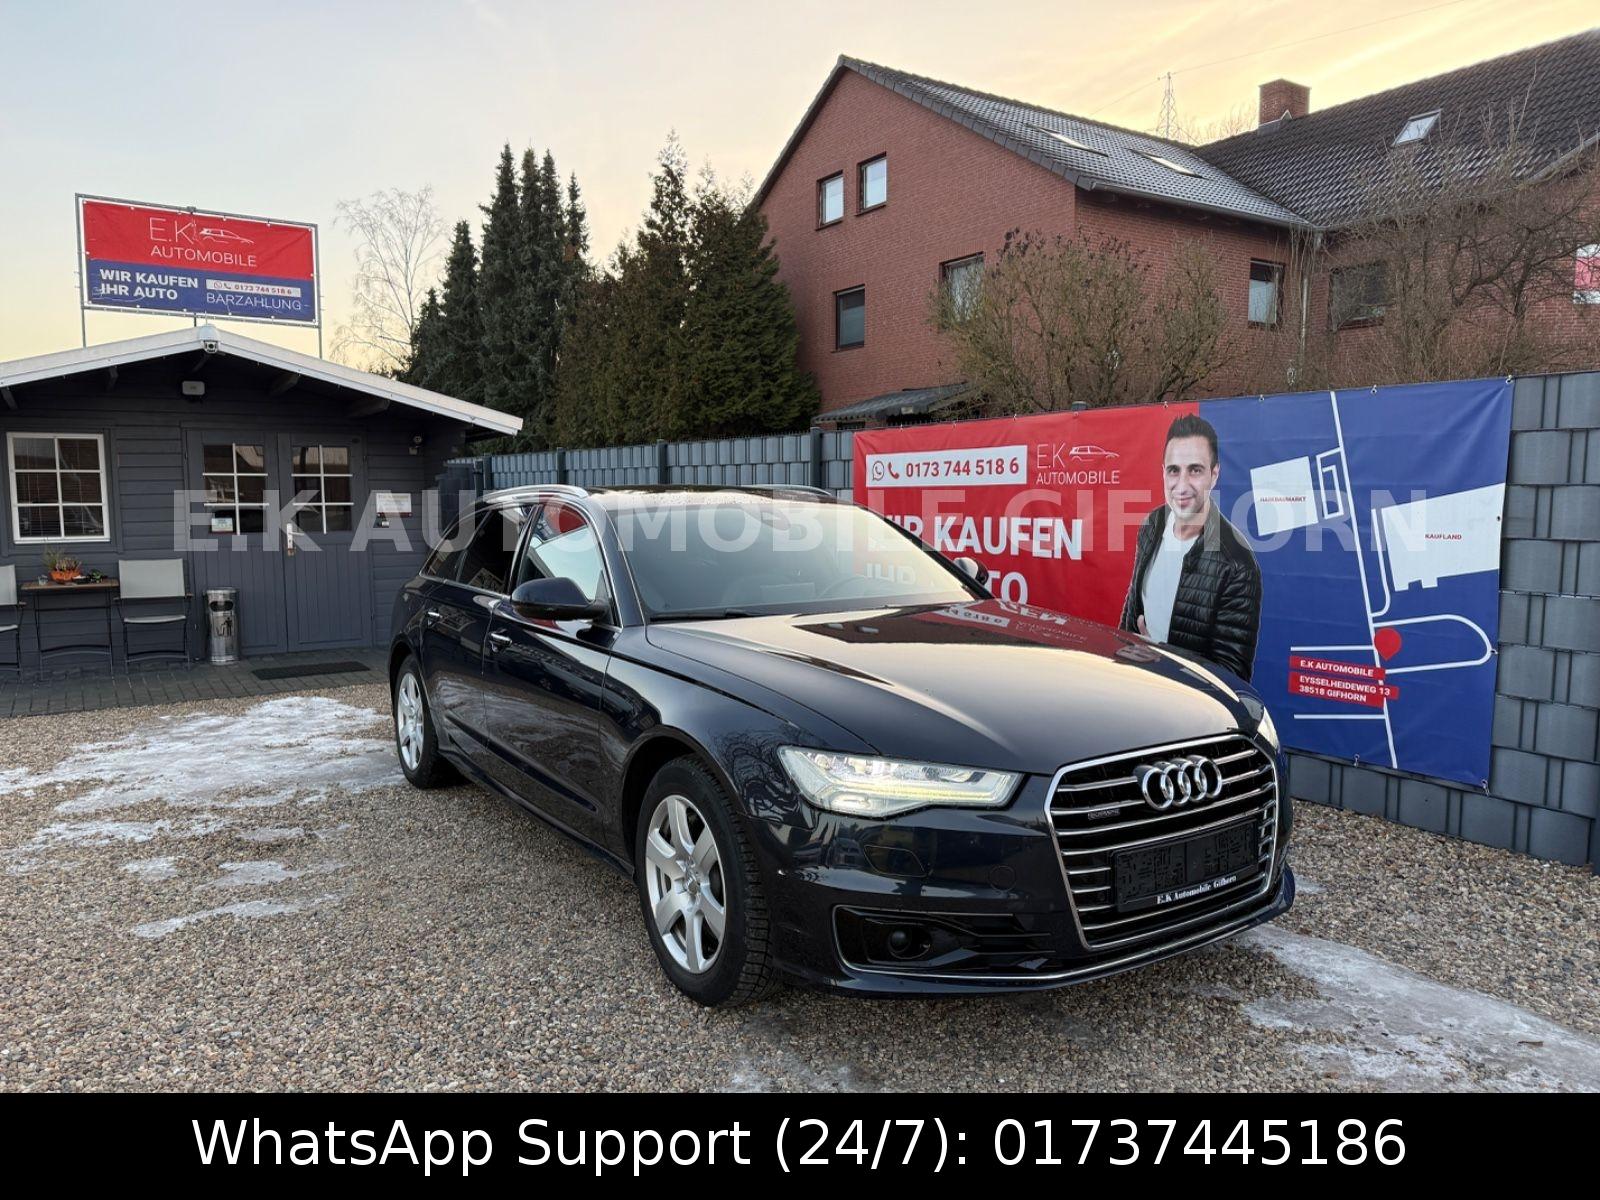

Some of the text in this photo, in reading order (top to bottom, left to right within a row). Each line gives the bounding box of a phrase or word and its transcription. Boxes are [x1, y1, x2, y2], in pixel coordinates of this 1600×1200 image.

[150, 217, 194, 244] E.K
[151, 245, 257, 268] AUTOMOBILE
[100, 268, 198, 289] WIR KAUFEN
[234, 284, 254, 292] 0173
[100, 283, 178, 300] IHR AUTO
[206, 292, 301, 310] BARZAHLUNG
[1036, 442, 1066, 470] E.K
[906, 456, 1020, 478] 0173 744 518 6
[1036, 470, 1121, 485] AUTOMOBILE
[934, 515, 1083, 560] KAUFEN
[1300, 660, 1375, 677] E.K AUTOMOBILE
[1299, 675, 1391, 696] EYSSELHEIDEWEG 13
[1299, 684, 1367, 702] 38518 GIFHORN
